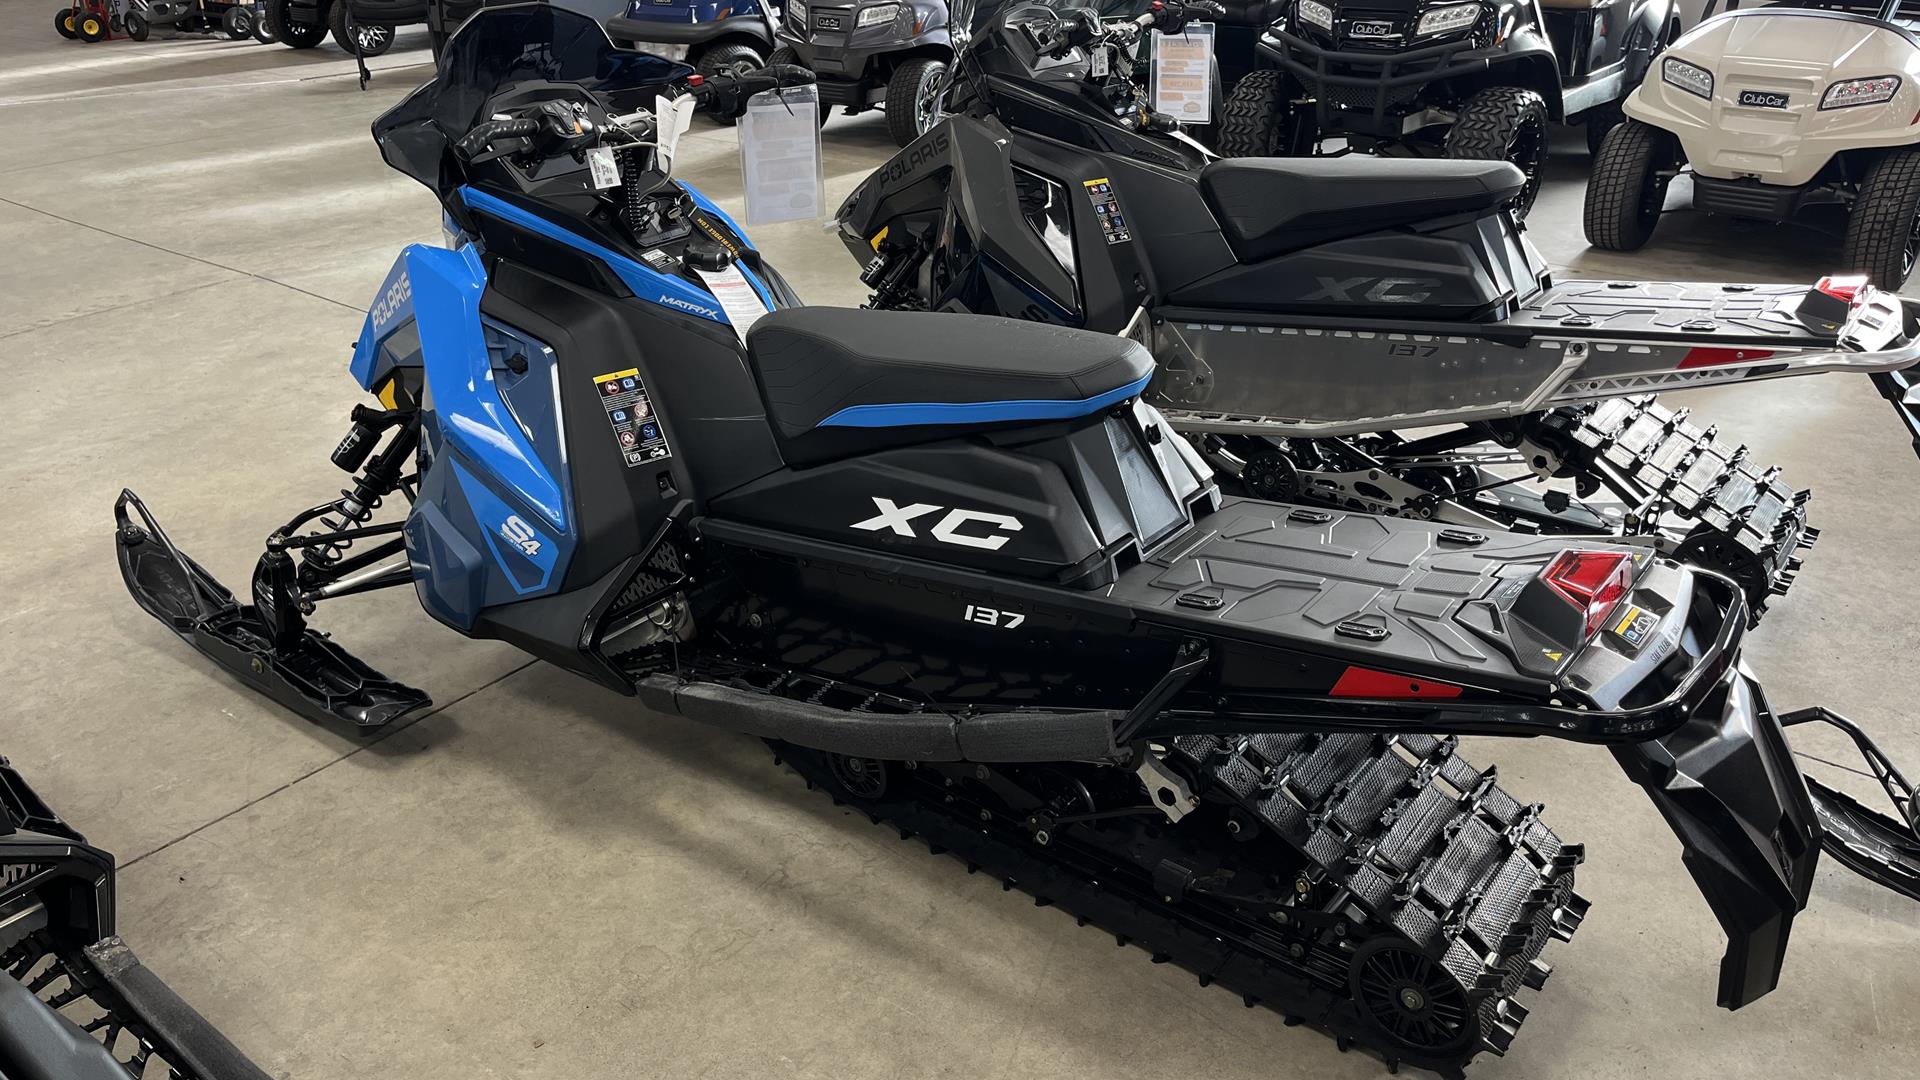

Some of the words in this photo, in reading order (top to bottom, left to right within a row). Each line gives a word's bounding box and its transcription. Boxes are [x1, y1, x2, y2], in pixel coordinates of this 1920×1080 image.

[879, 132, 950, 189] POLARIS
[372, 270, 412, 333] POLARIS
[1299, 276, 1443, 304] XC
[659, 295, 719, 321] MATRYX
[1388, 343, 1440, 359] 137
[501, 515, 542, 556] S4
[849, 496, 1024, 551] XC
[964, 604, 1026, 629] 137
